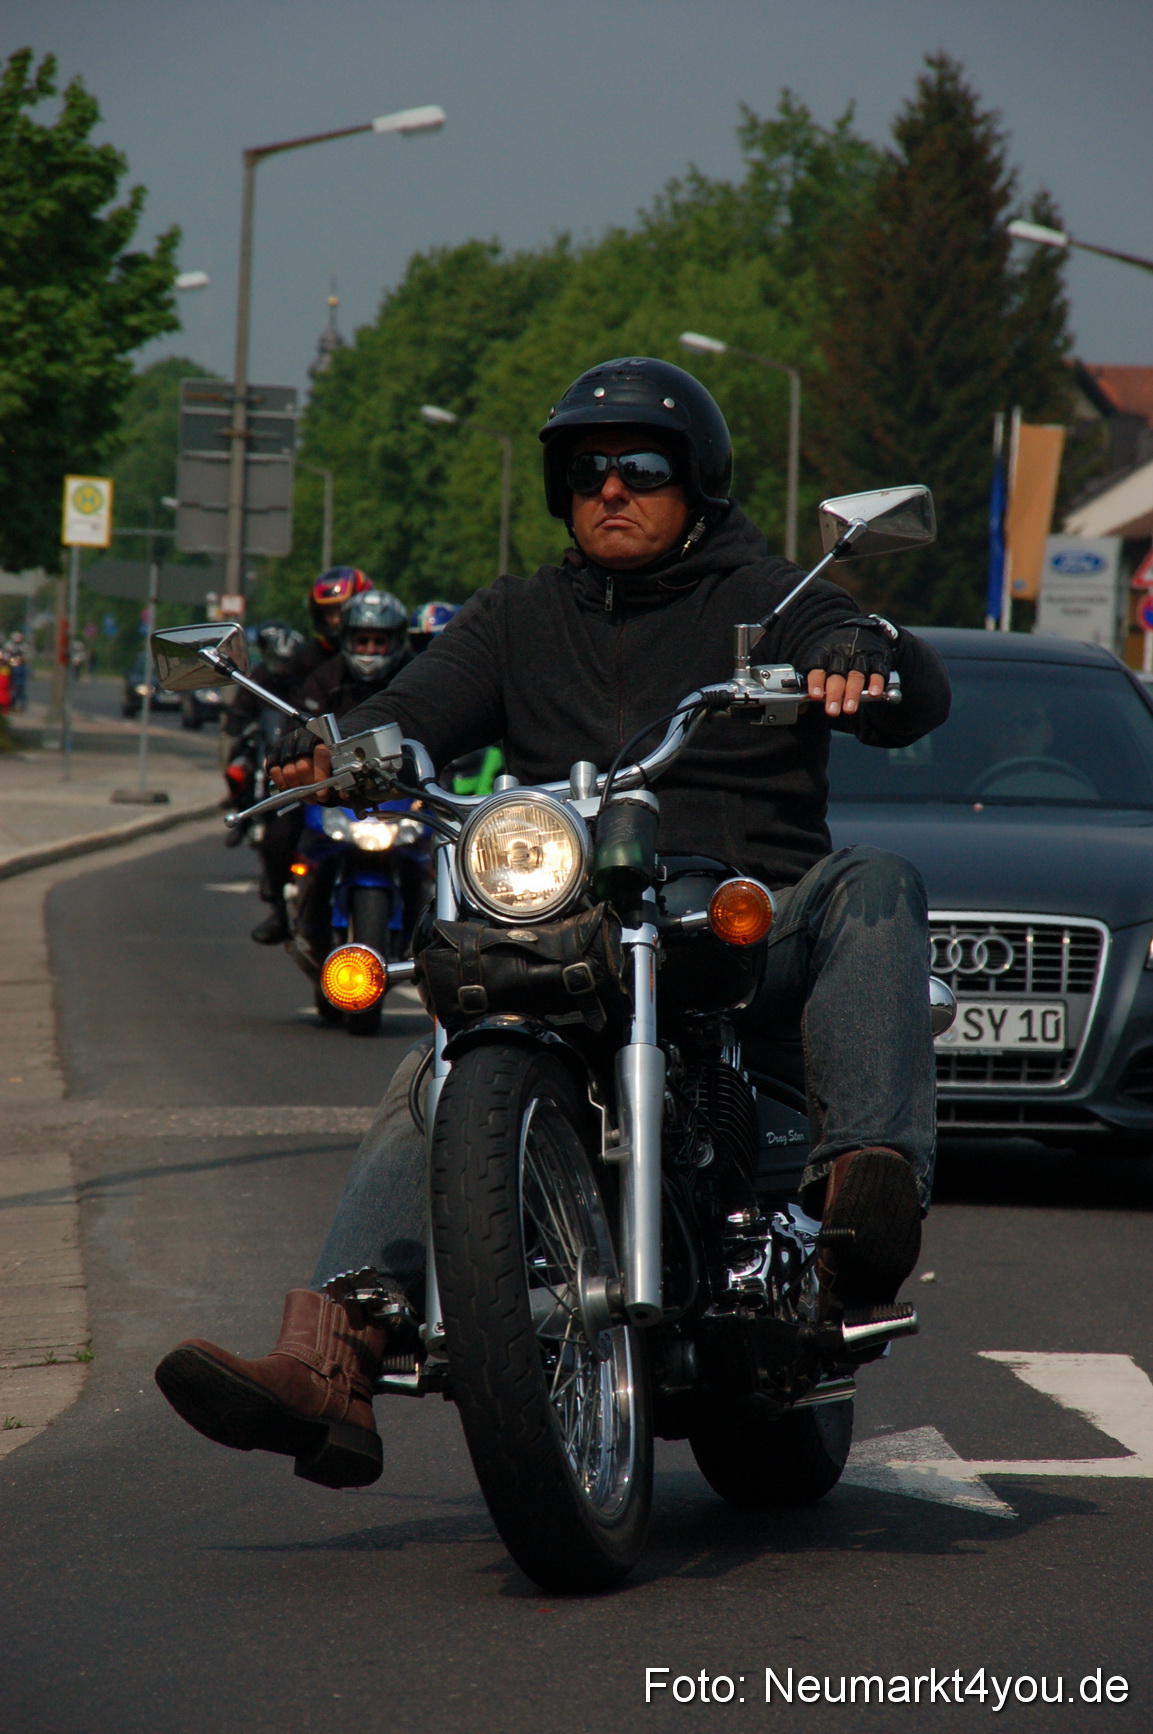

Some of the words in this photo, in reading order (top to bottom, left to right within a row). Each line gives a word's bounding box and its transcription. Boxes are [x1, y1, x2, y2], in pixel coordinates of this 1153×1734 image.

[963, 1008, 1008, 1041] SY
[1018, 1009, 1060, 1042] 10
[766, 1131, 787, 1146] Drag
[788, 1129, 805, 1141] Star
